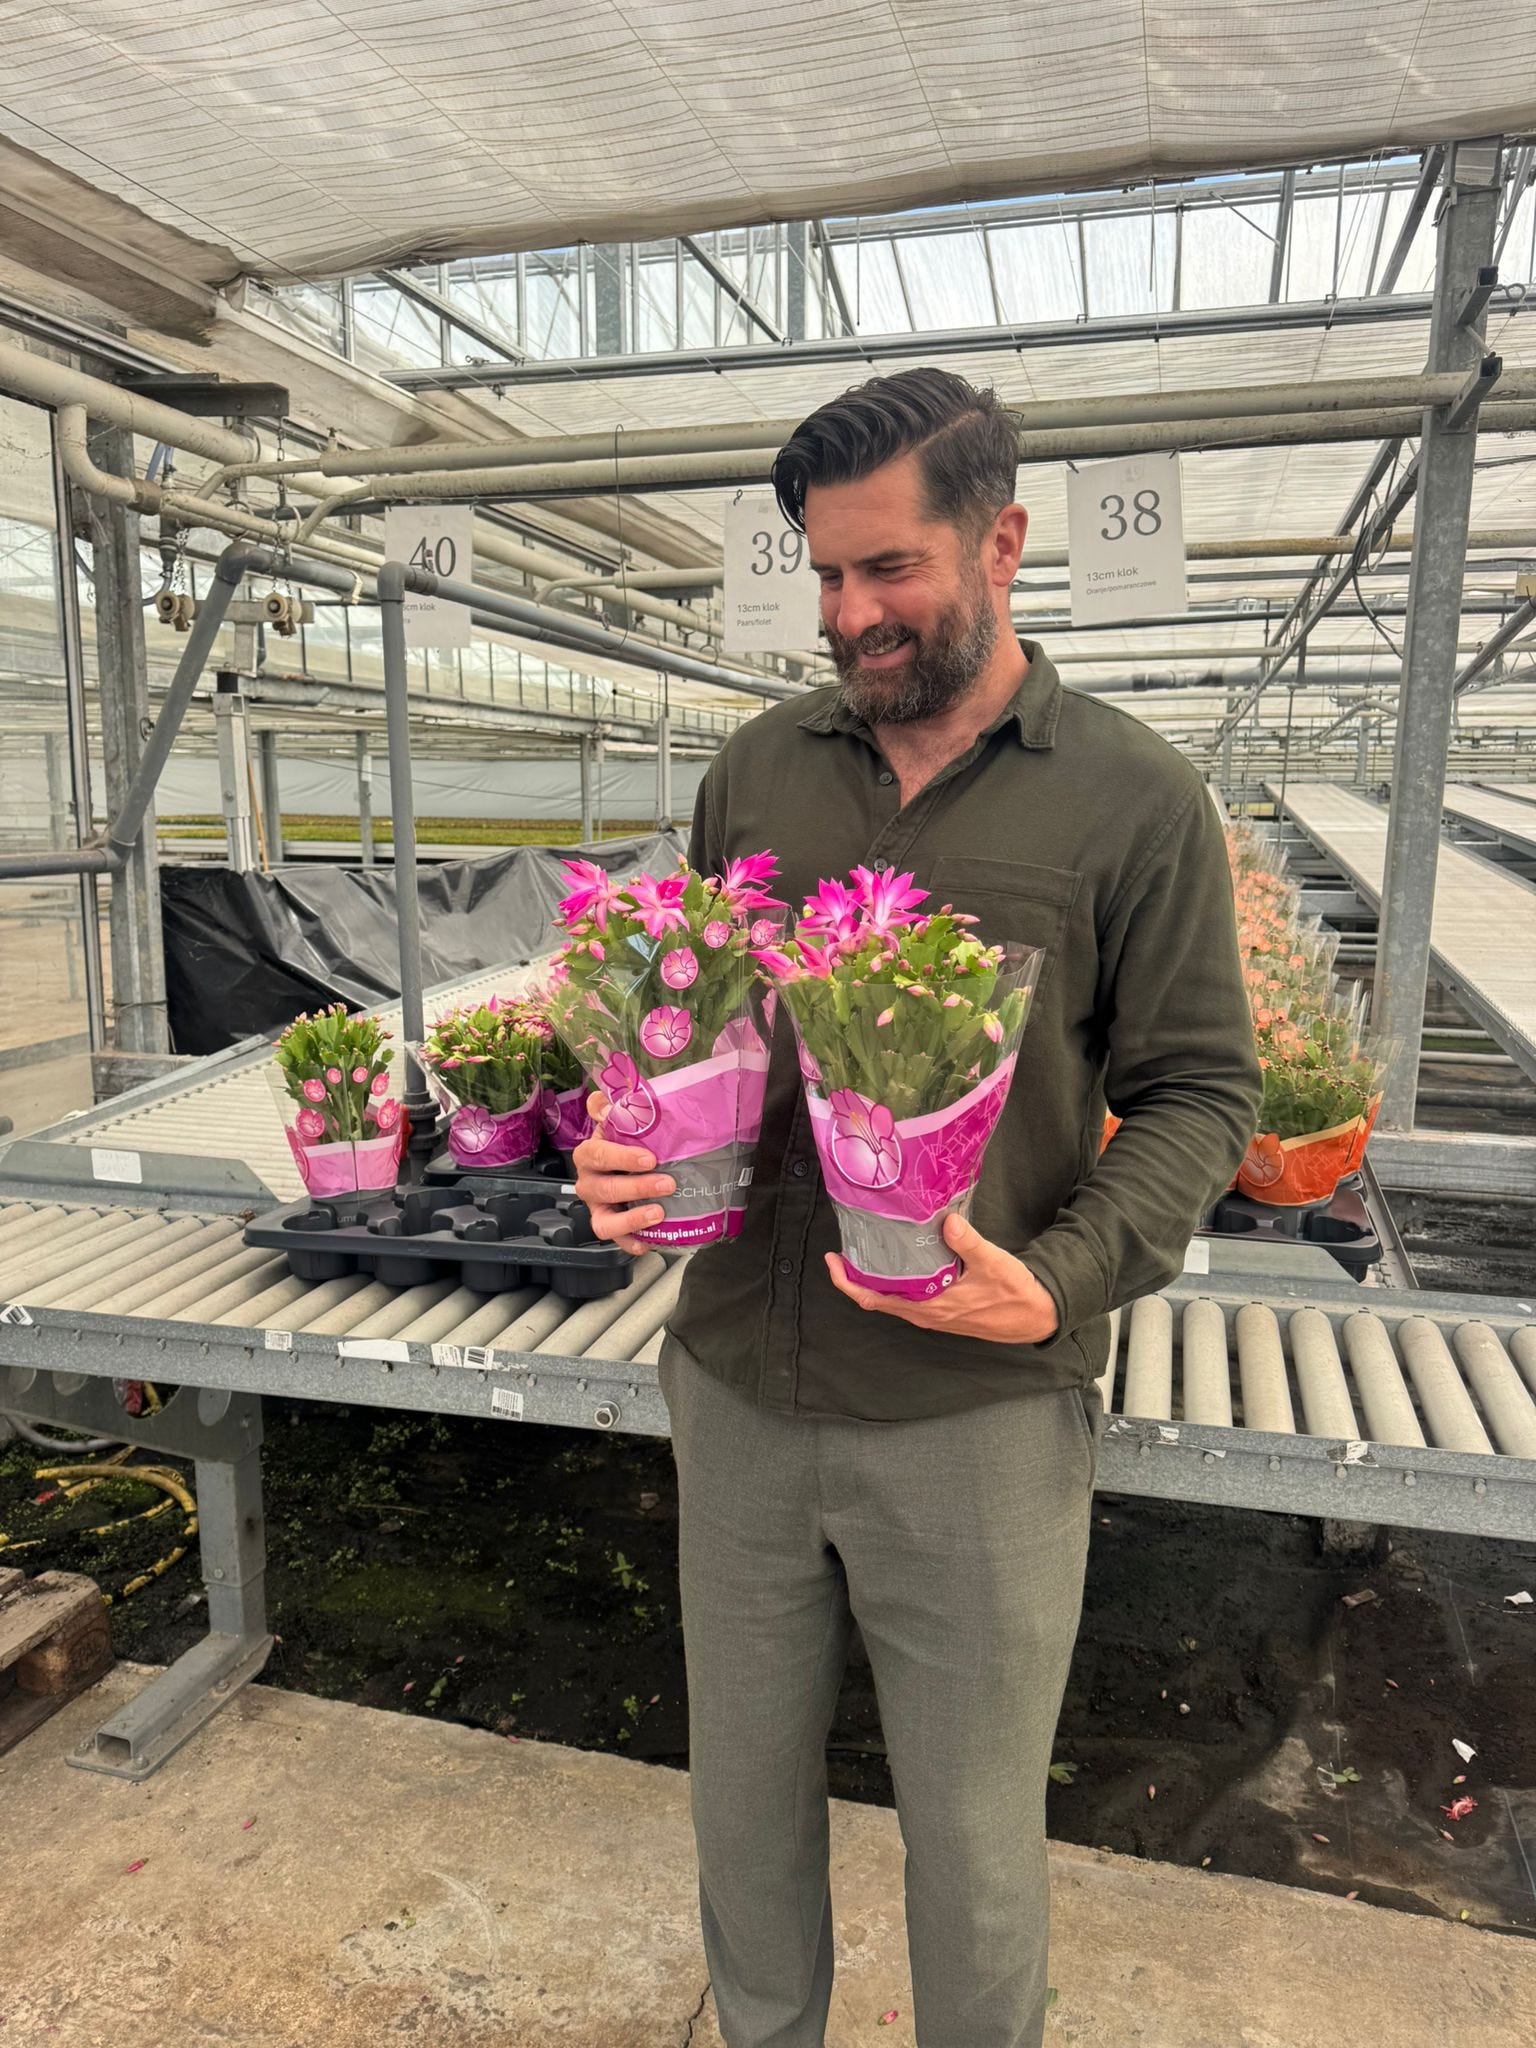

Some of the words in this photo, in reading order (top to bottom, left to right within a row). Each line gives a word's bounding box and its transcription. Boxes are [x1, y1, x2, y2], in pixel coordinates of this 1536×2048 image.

[1100, 489, 1162, 541] 38
[408, 536, 457, 578] 40
[751, 529, 803, 576] 39
[1086, 570, 1115, 582] 13cm
[1117, 566, 1138, 578] klok
[737, 603, 761, 613] 13cm
[762, 602, 781, 611] klok
